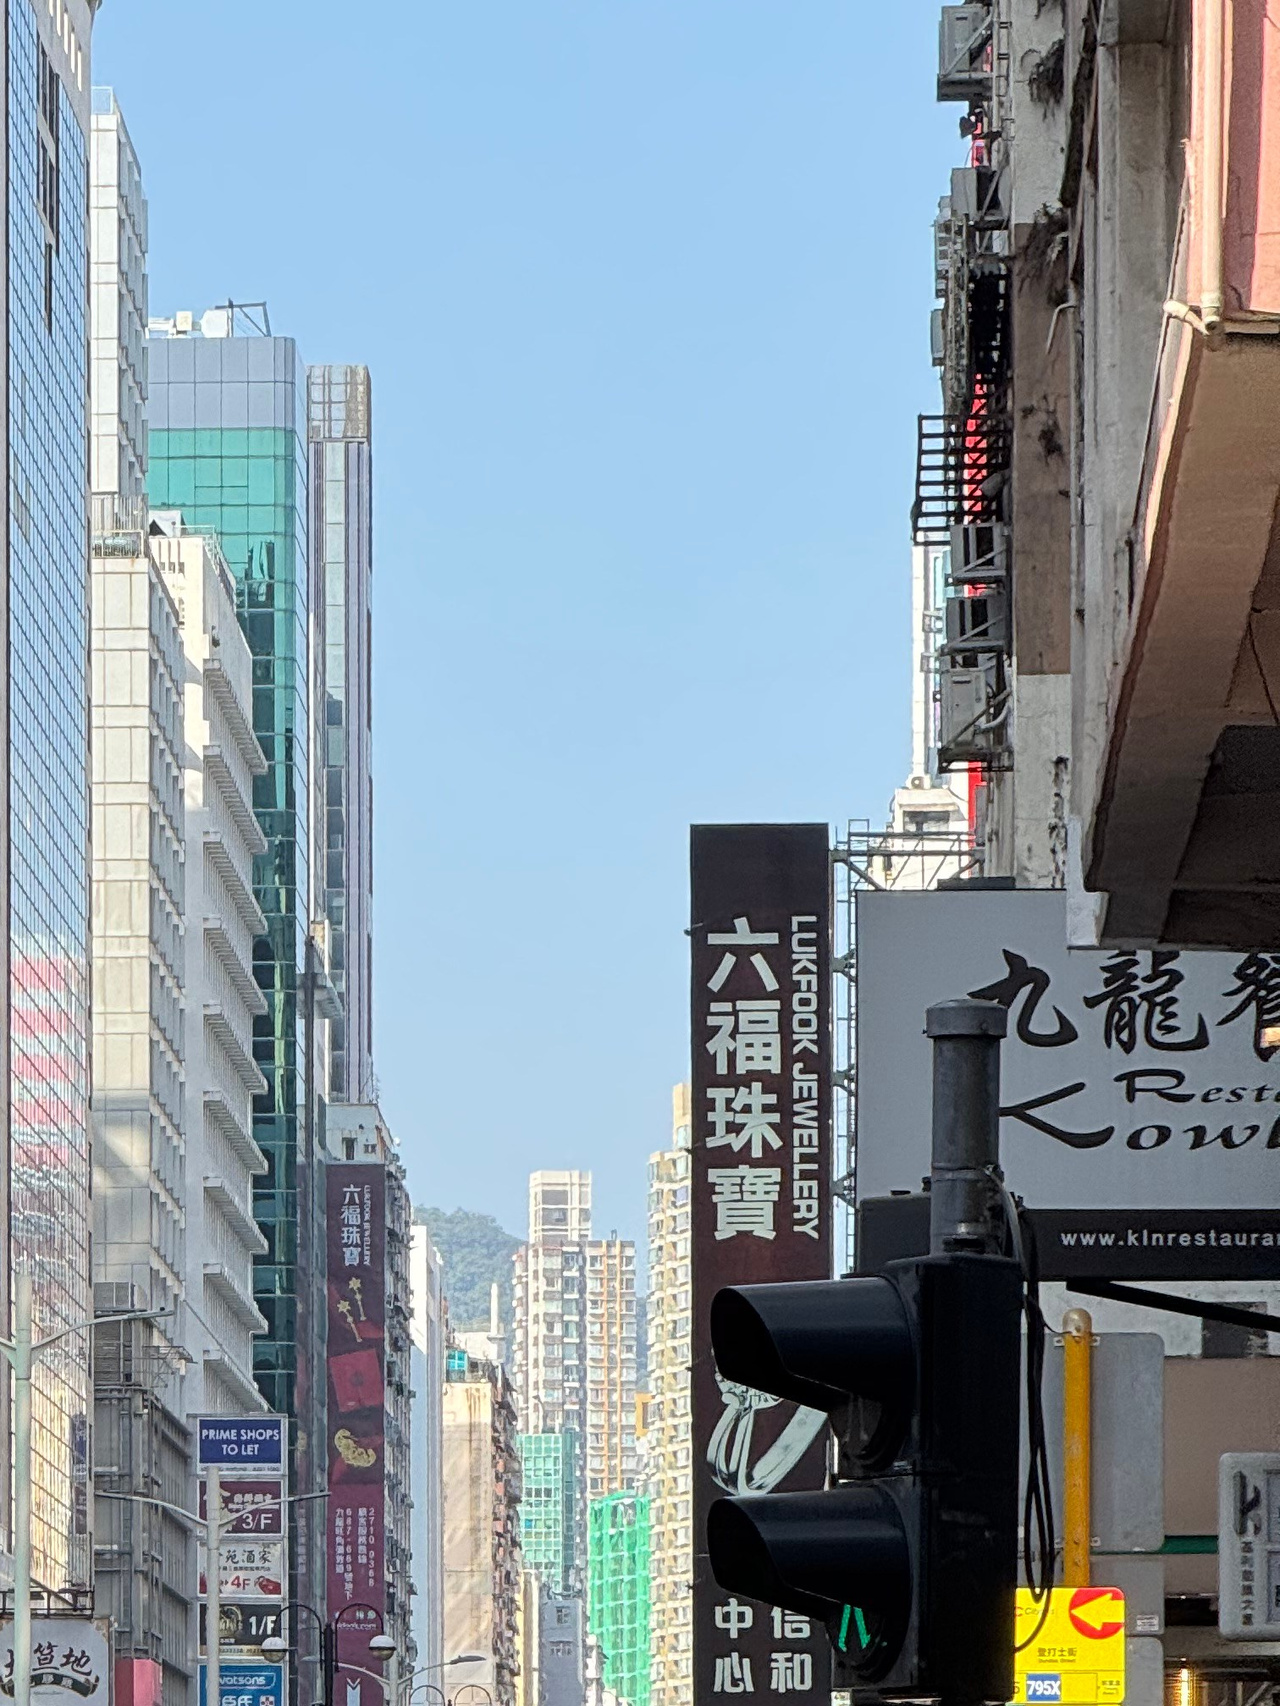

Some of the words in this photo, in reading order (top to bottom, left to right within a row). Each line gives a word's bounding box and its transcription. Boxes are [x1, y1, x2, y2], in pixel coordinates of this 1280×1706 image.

[791, 916, 818, 1053] LUKFOOK
[707, 916, 783, 1241] 六福珠寶
[791, 1063, 818, 1239] JEWELLERY
[340, 1184, 362, 1267] 六福珠寶
[201, 1429, 238, 1441] PRIME
[240, 1429, 280, 1441] SHOPS
[221, 1444, 239, 1456] TO
[241, 1444, 260, 1456] LET
[241, 1513, 273, 1531] 3/F
[218, 1549, 272, 1565] 苑酒家
[230, 1575, 251, 1591] 4F
[248, 1615, 277, 1636] 1/F
[1037, 1647, 1077, 1658] 登打士街
[1027, 1680, 1061, 1696] 795X
